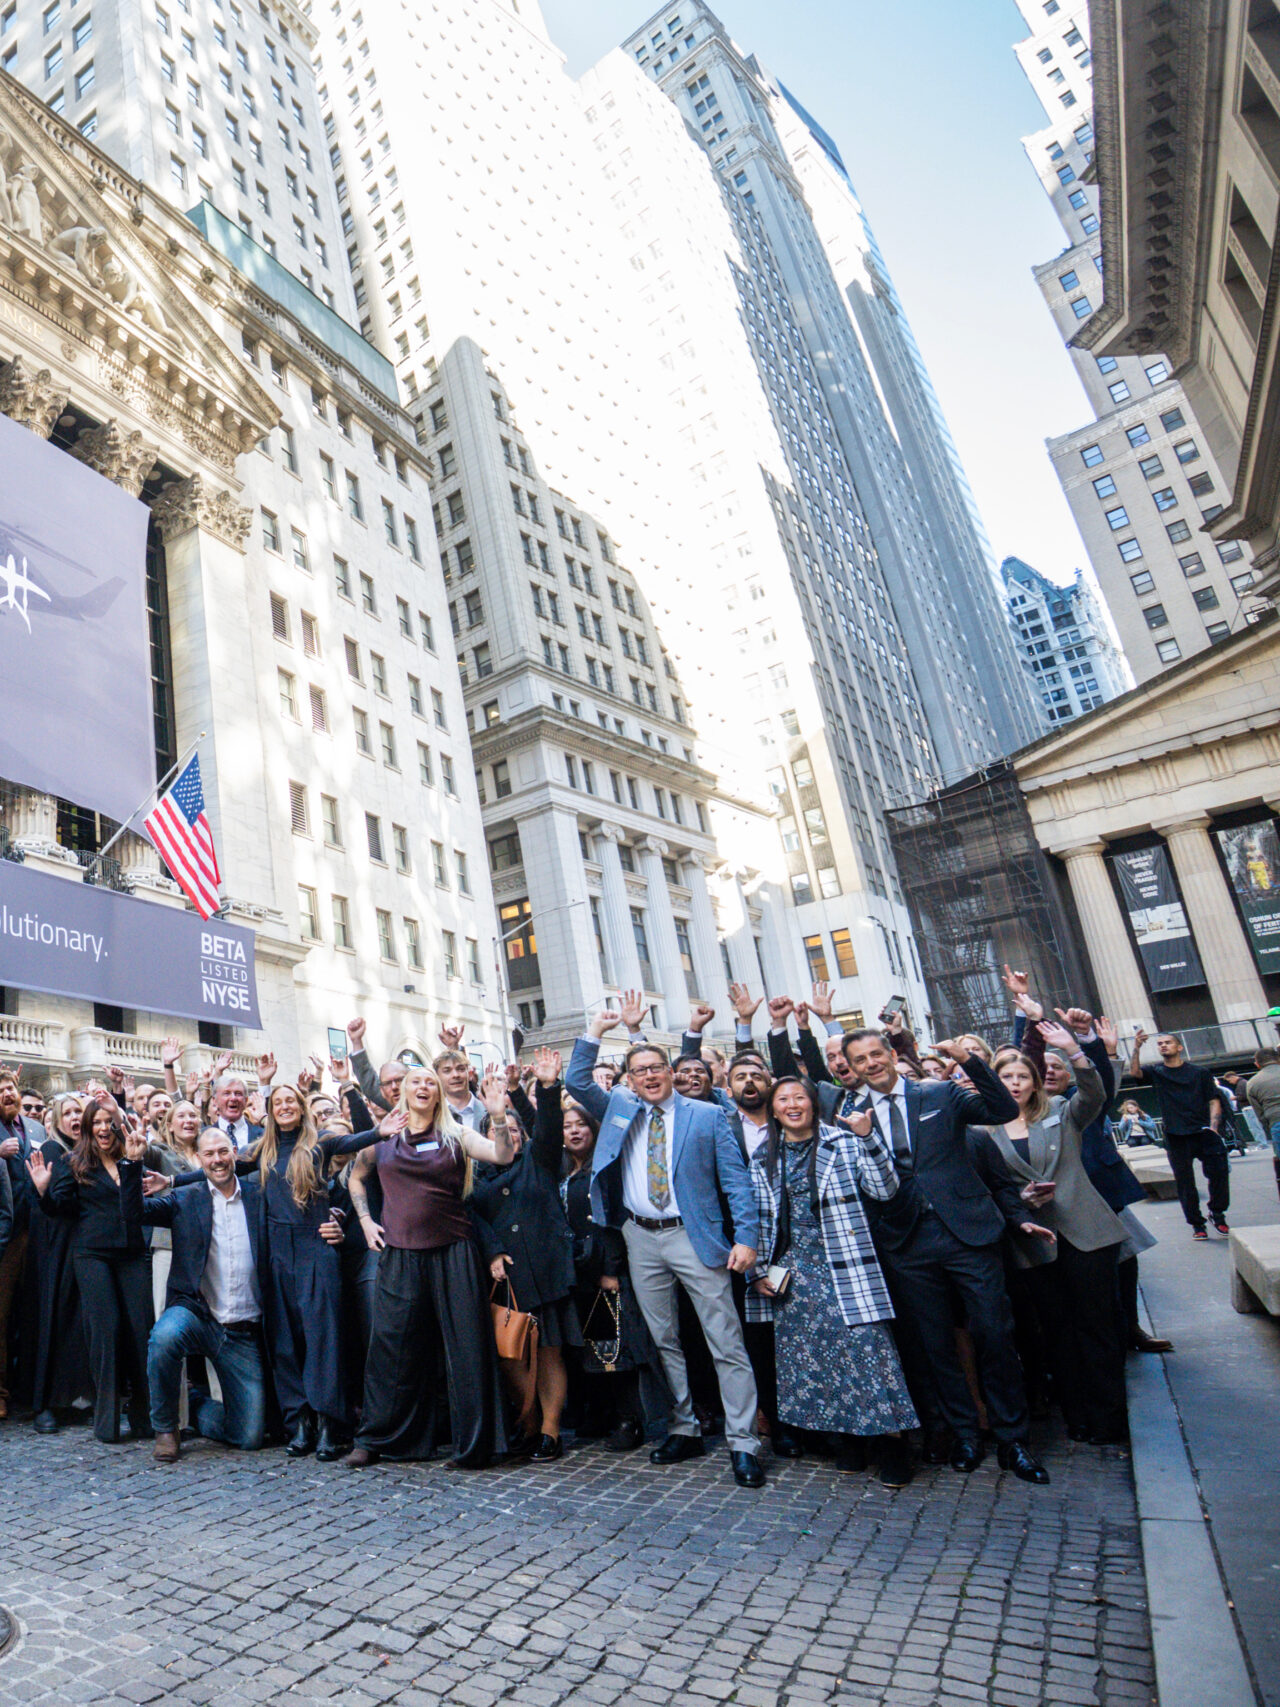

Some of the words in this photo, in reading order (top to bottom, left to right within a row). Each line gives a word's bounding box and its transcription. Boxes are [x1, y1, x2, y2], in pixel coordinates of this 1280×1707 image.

[201, 932, 246, 963] BETA
[201, 961, 248, 982] LISTED
[202, 980, 251, 1011] NYSE
